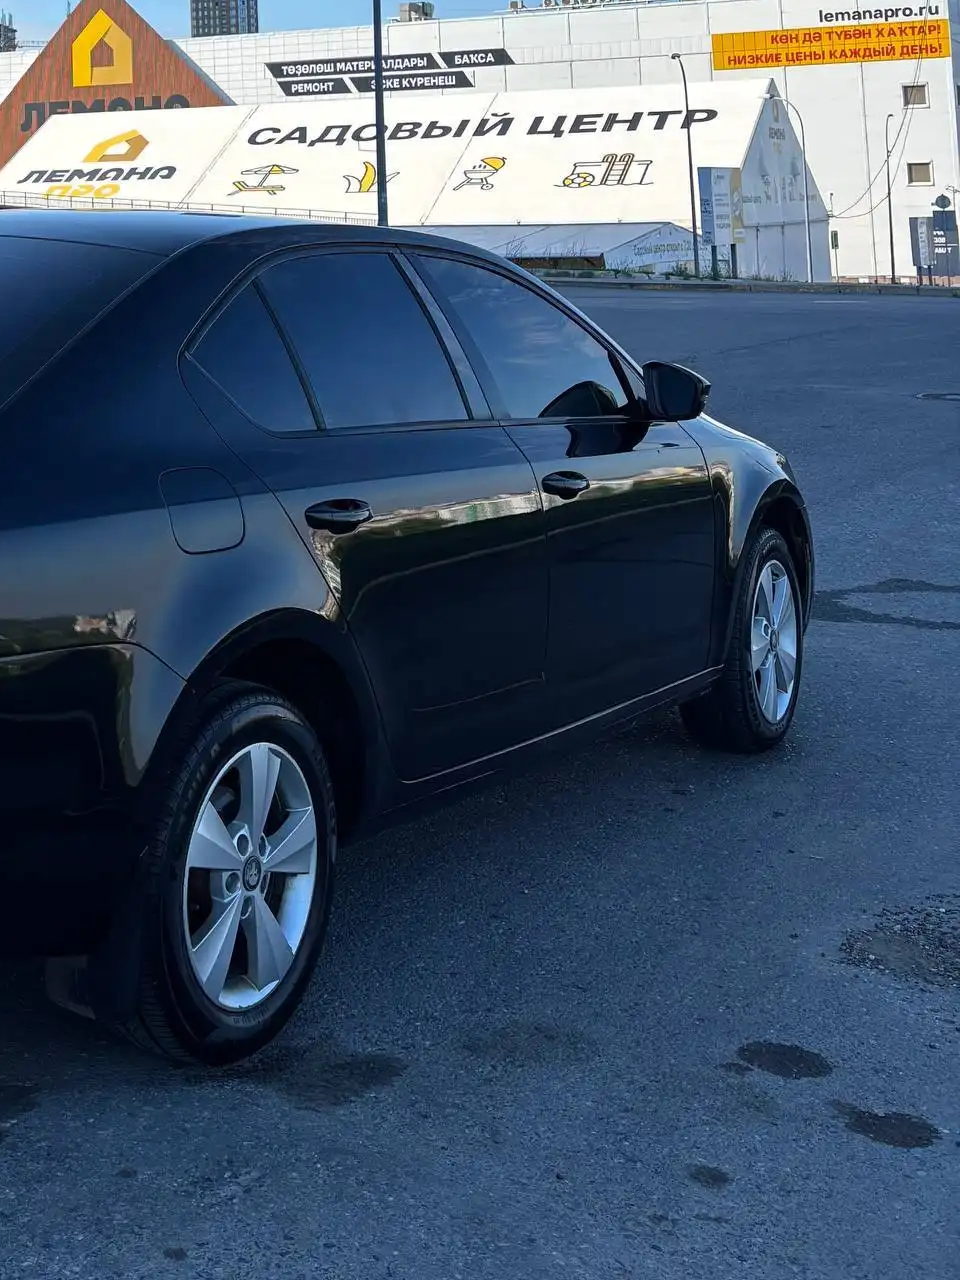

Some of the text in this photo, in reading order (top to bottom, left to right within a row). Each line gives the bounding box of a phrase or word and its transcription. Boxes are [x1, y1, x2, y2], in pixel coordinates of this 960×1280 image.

[818, 5, 939, 23] lemanapro.ru
[770, 32, 799, 45] КӨН
[802, 31, 822, 44] ДӘ
[825, 28, 871, 41] ТҮБӘН
[454, 52, 495, 65] БАҠСА
[727, 42, 943, 66] НИЗКИЕ ЦЕНЫ КАЖДЫЙ ДЕНЬ!
[291, 82, 334, 93] РЕМОНТ
[402, 75, 456, 88] КҮРЕНЕШ
[247, 108, 719, 148] САДОВЫЙ ЦЕНТР
[16, 165, 177, 184] ЛЕМАНА
[44, 183, 121, 200] ПРО
